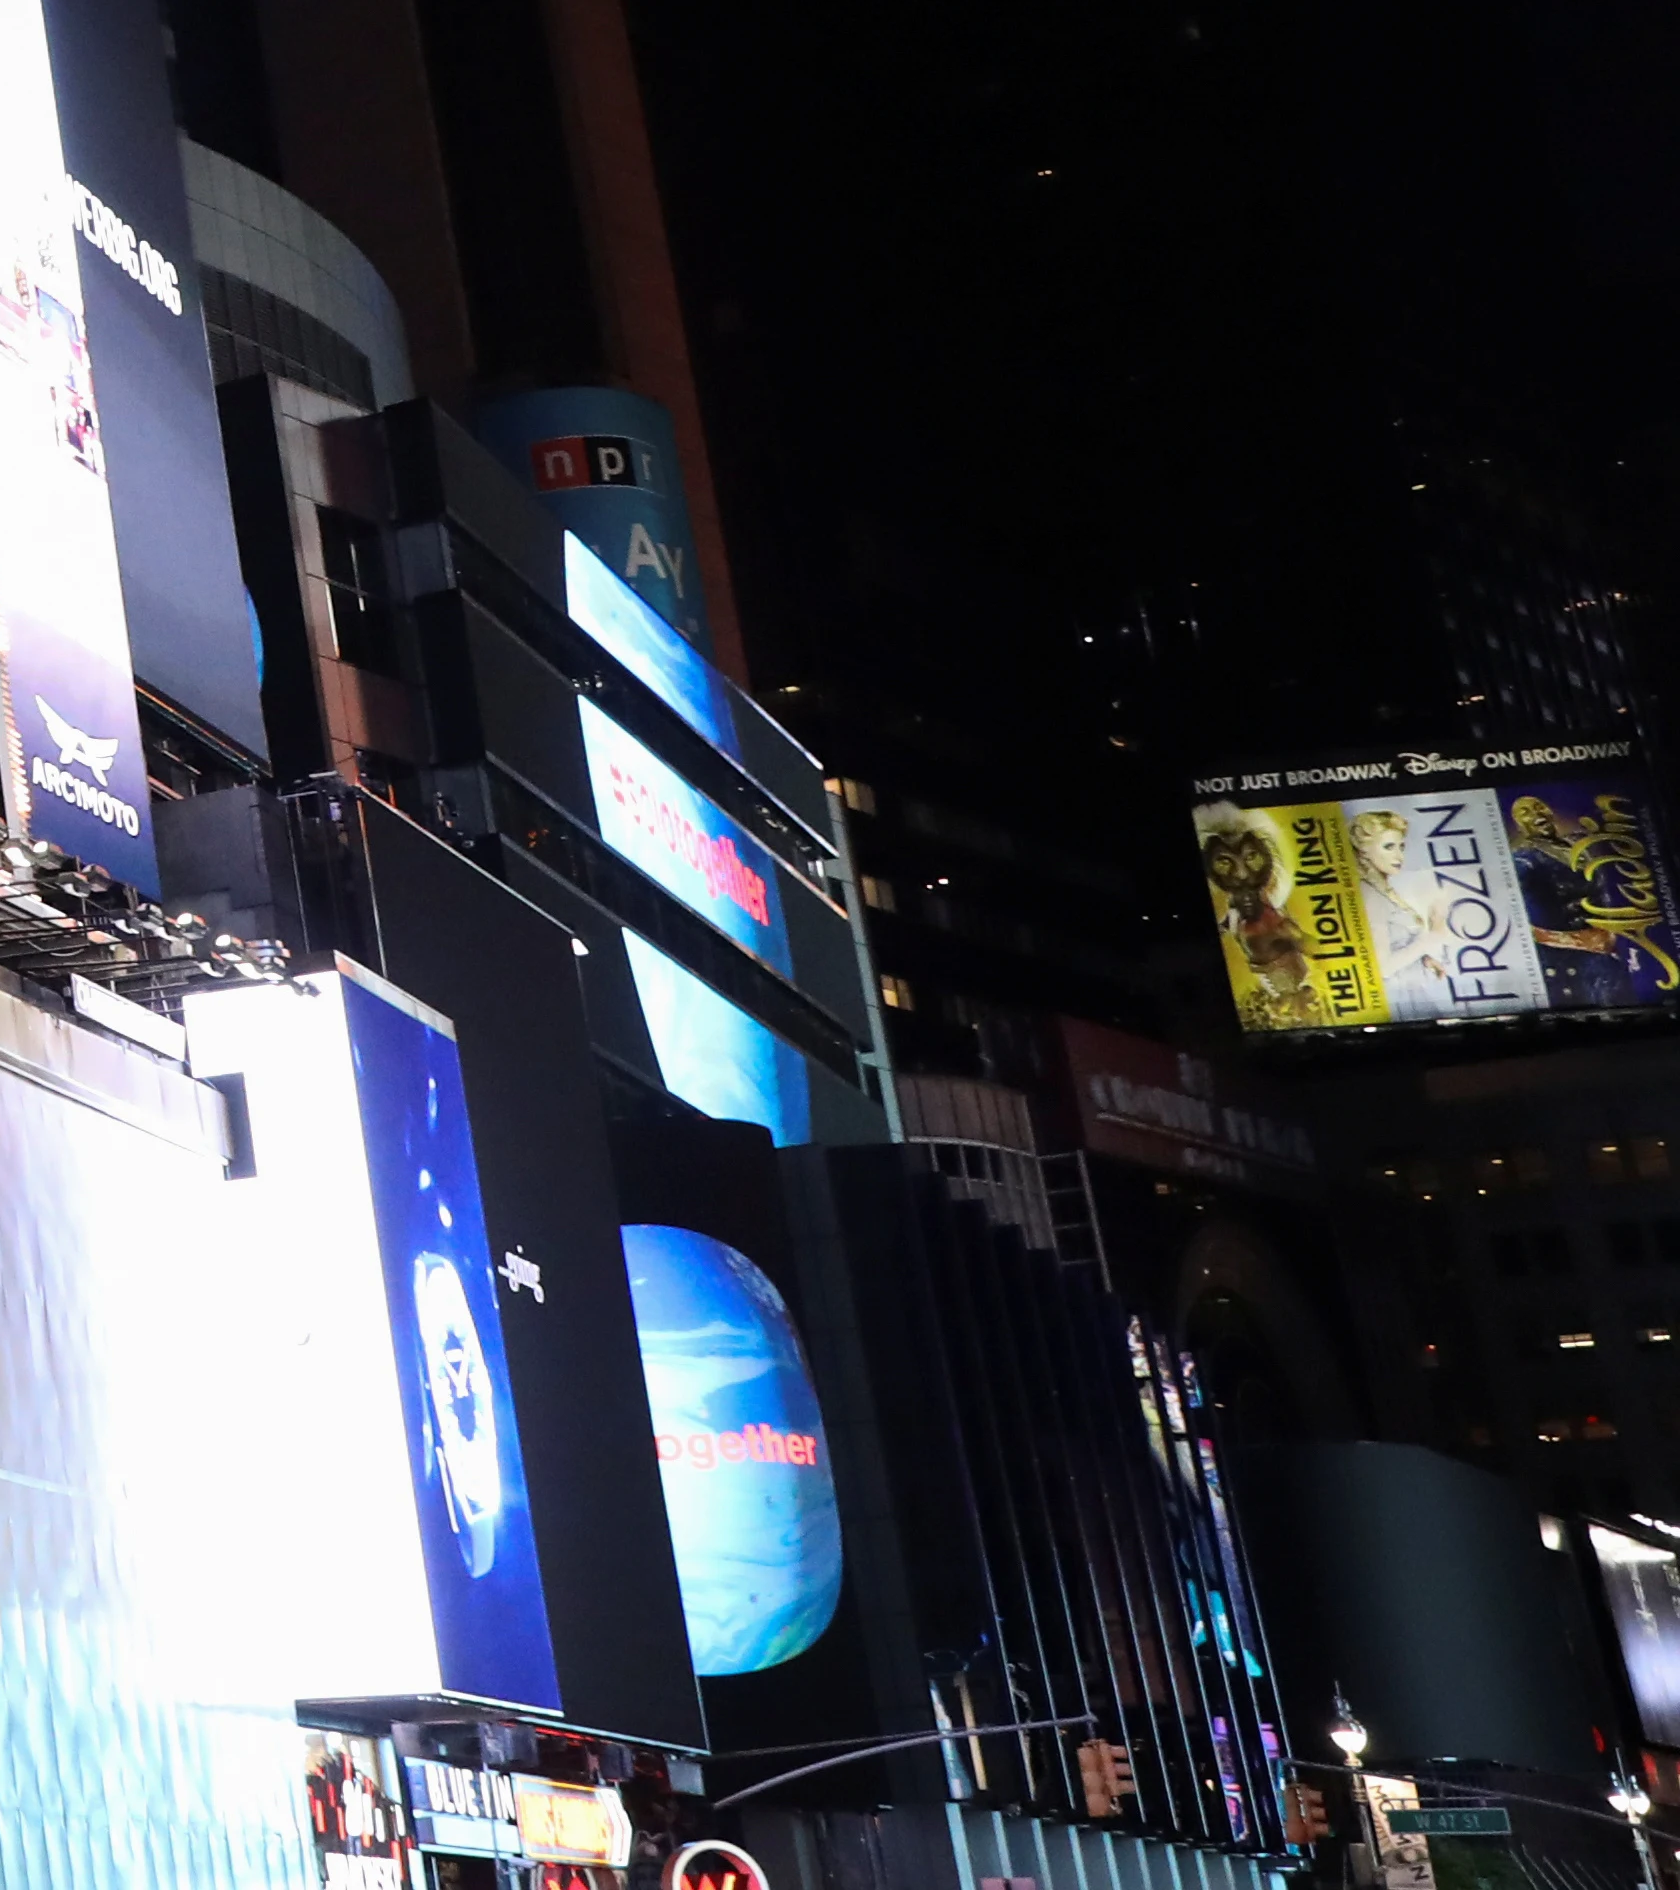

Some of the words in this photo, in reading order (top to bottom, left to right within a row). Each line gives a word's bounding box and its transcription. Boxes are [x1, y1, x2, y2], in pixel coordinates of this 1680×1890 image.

[543, 446, 652, 481] npr
[32, 756, 140, 837] ARCIMOTO
[1194, 776, 1234, 796] NOT
[1240, 772, 1281, 793] JUST
[1287, 761, 1398, 788] BROADWAY,
[1483, 750, 1515, 770] ON
[1520, 740, 1632, 766] BROADWAY
[1291, 816, 1338, 888] KING
[1309, 894, 1355, 961] LION
[1417, 802, 1520, 1006] FROZEN
[1328, 966, 1359, 1018] THE
[1414, 1814, 1431, 1829] W
[1438, 1814, 1455, 1829] 47
